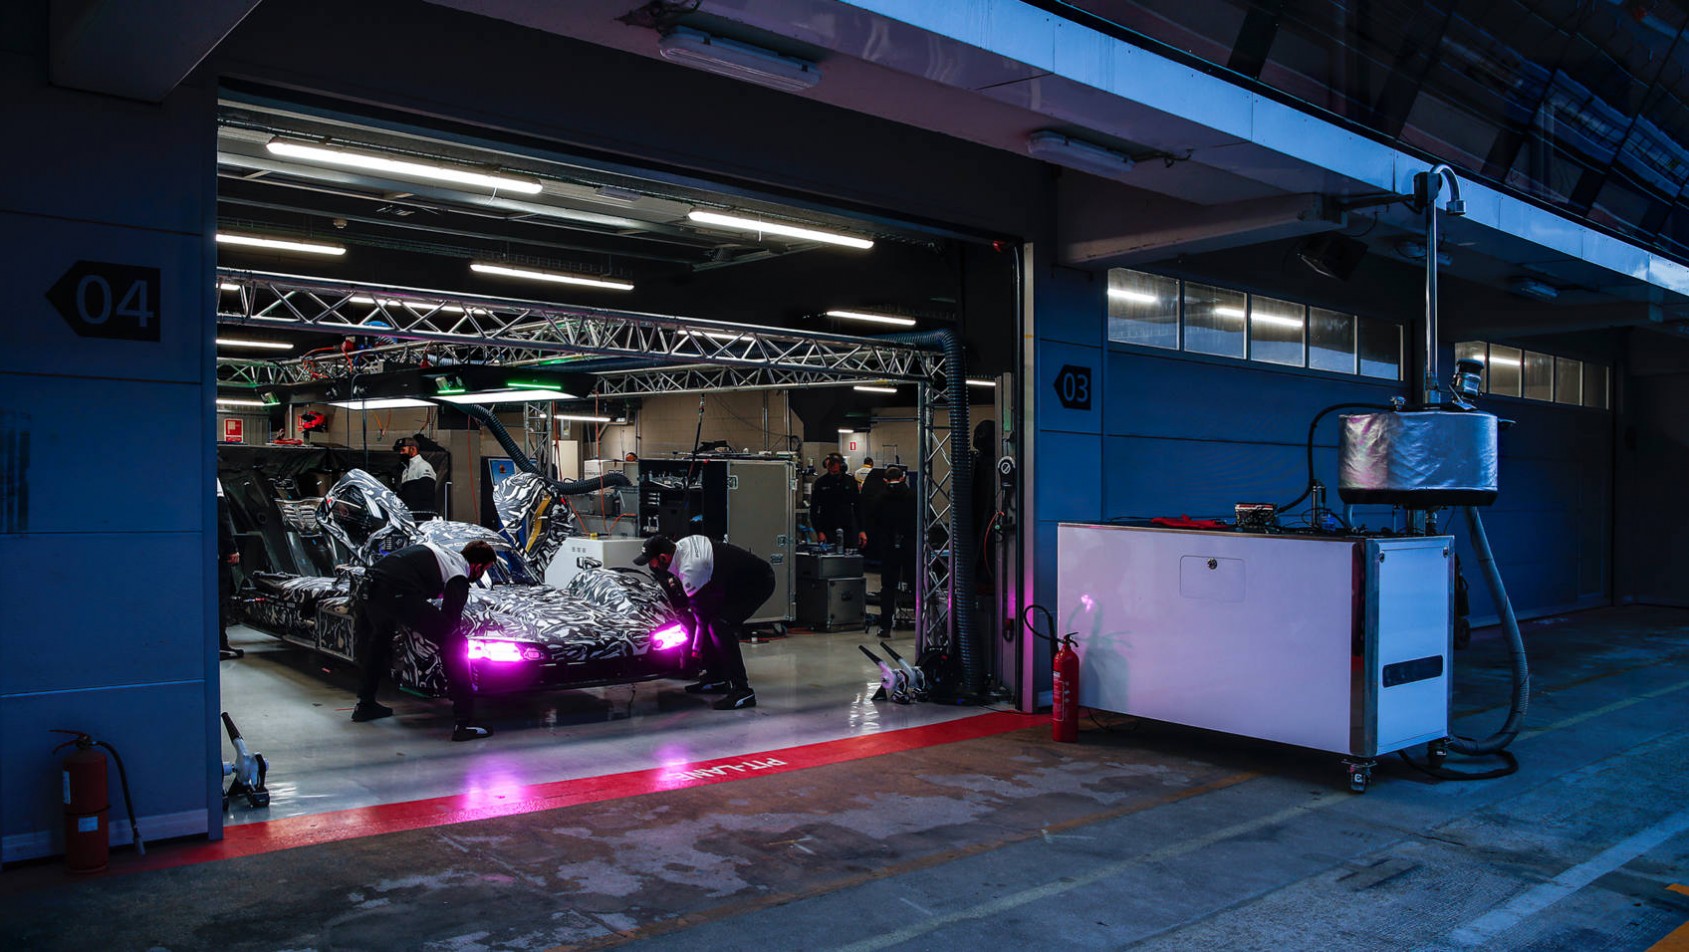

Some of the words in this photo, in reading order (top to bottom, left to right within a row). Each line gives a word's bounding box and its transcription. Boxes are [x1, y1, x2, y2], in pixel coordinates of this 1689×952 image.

[76, 274, 154, 328] 04
[1063, 372, 1089, 403] 03
[667, 757, 788, 780] PIT-LANE
